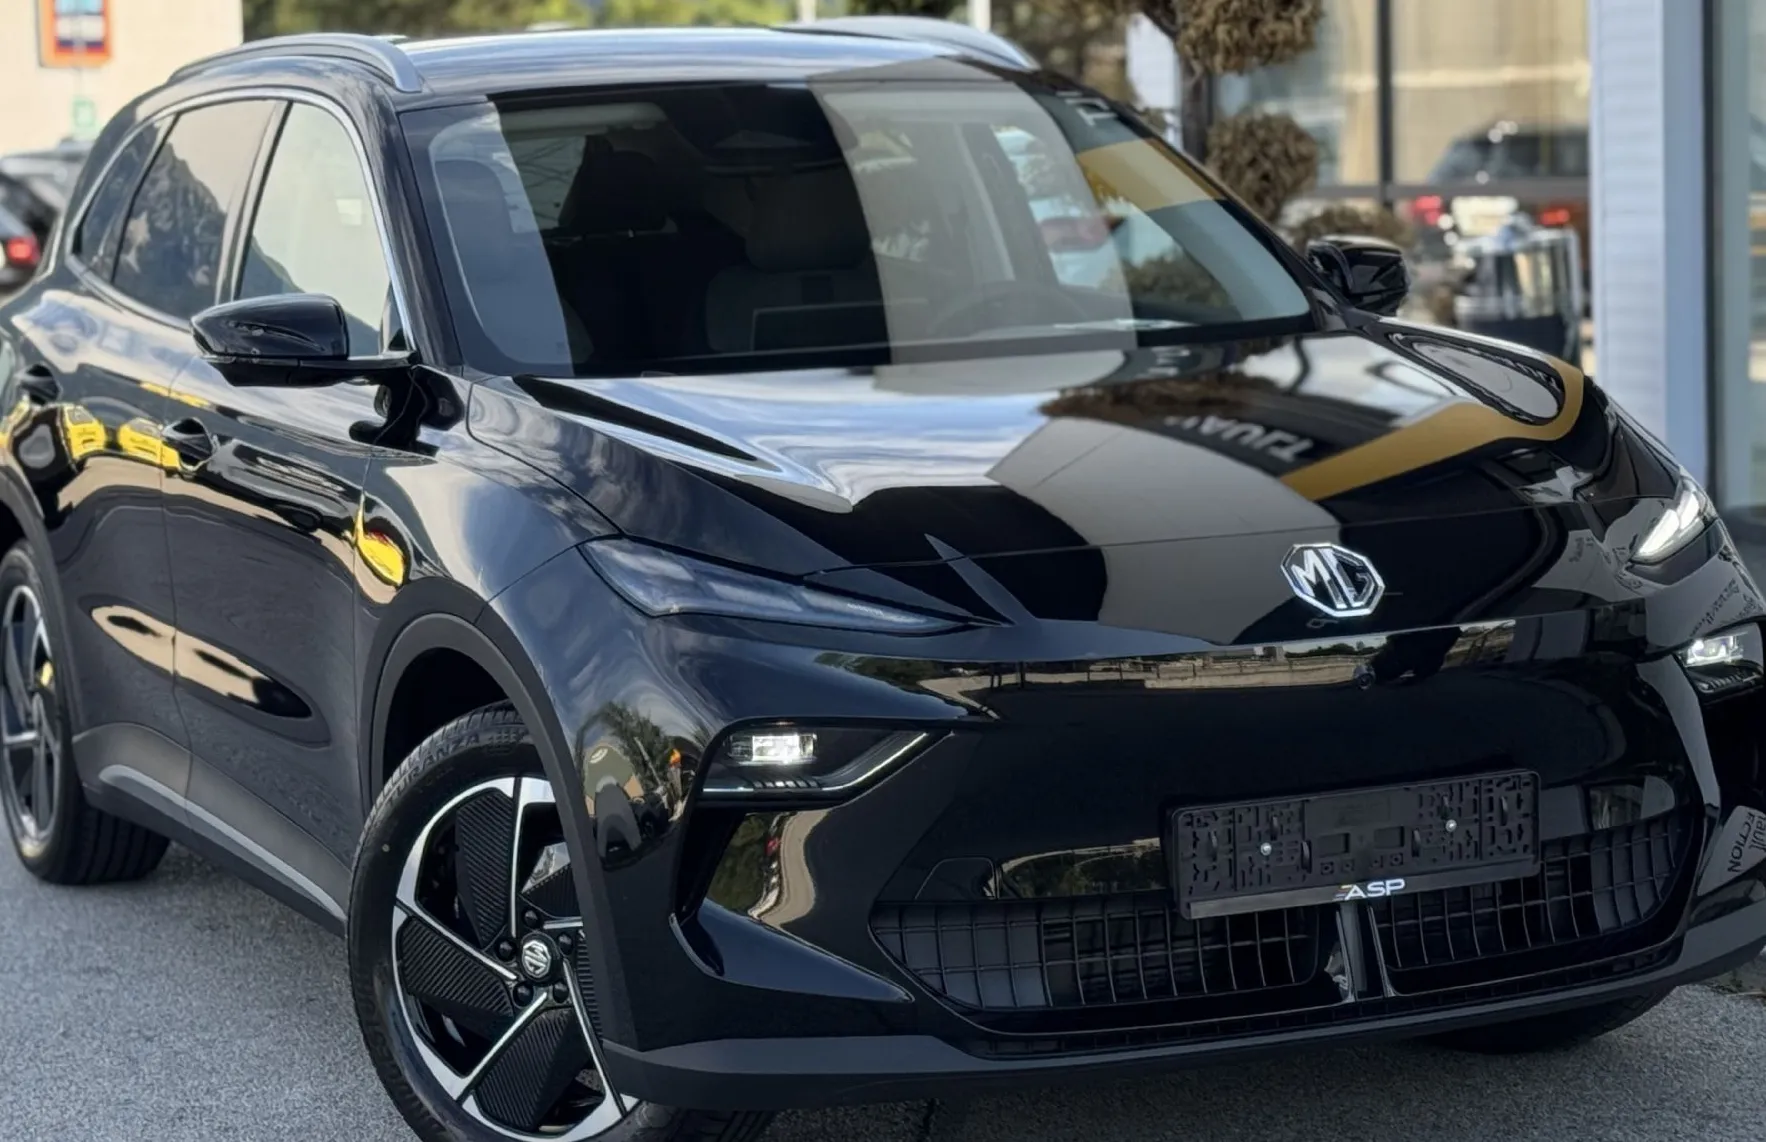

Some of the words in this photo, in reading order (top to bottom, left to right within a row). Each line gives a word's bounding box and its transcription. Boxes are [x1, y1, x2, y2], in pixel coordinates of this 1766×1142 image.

[1289, 547, 1376, 609] MG
[1343, 878, 1406, 901] ASP
[524, 942, 549, 976] MG
